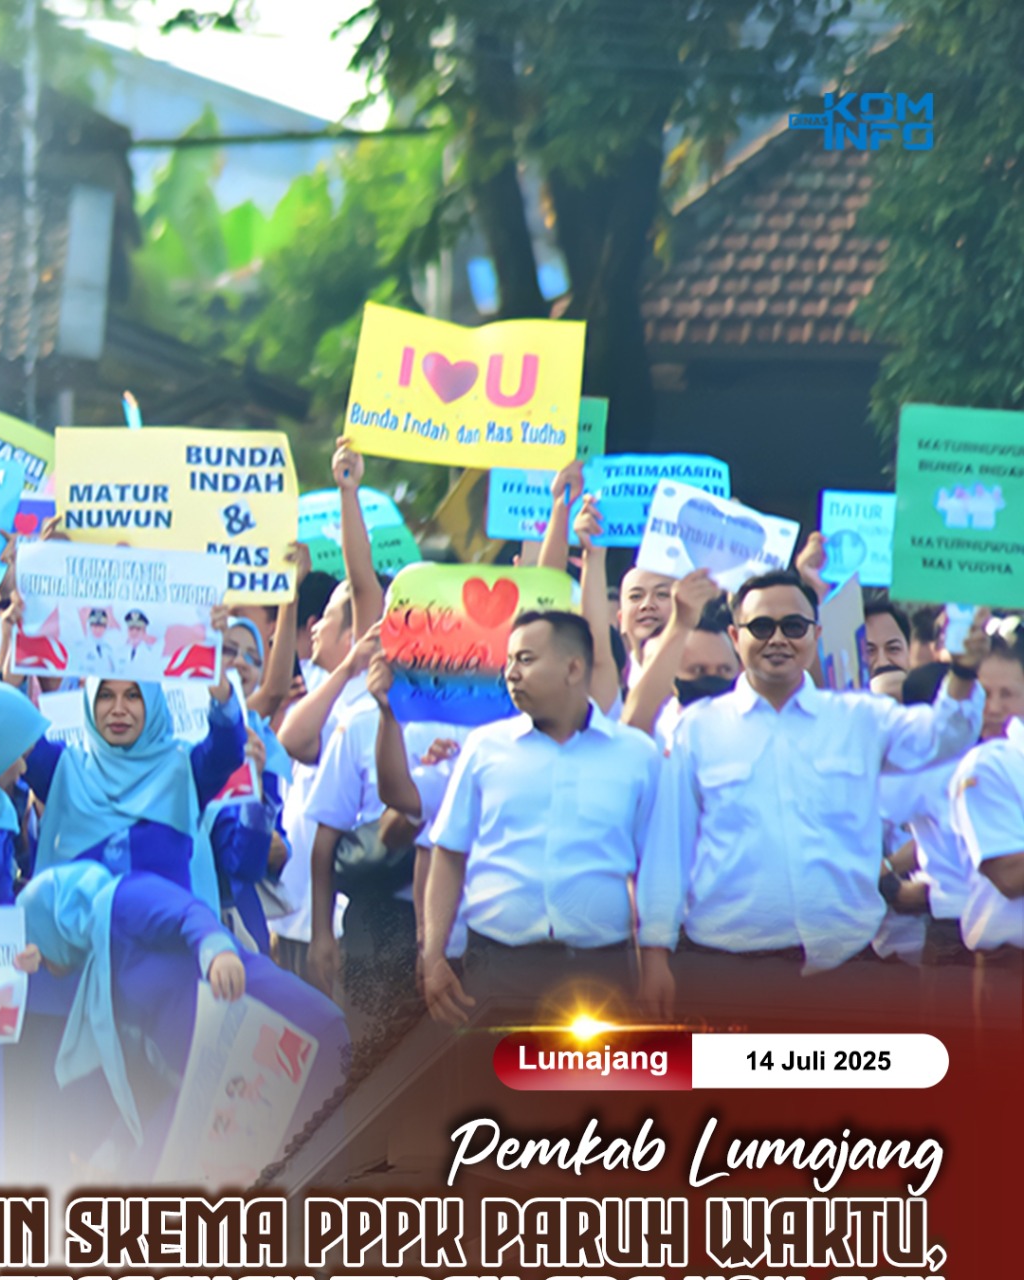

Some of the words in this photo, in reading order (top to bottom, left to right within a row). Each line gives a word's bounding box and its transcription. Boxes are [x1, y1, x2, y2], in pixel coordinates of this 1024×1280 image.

[398, 346, 415, 388] I
[485, 354, 539, 408] U
[350, 402, 399, 431] Bunda
[403, 412, 450, 442] Indah
[456, 425, 481, 445] dan
[485, 420, 514, 443] Mas
[520, 420, 566, 446] Yudha
[186, 446, 286, 468] BUNDA
[190, 472, 284, 493] INDAH
[69, 484, 169, 504] MATUR
[65, 510, 173, 529] NUWUN
[223, 503, 256, 537] &
[227, 572, 290, 592] DHA
